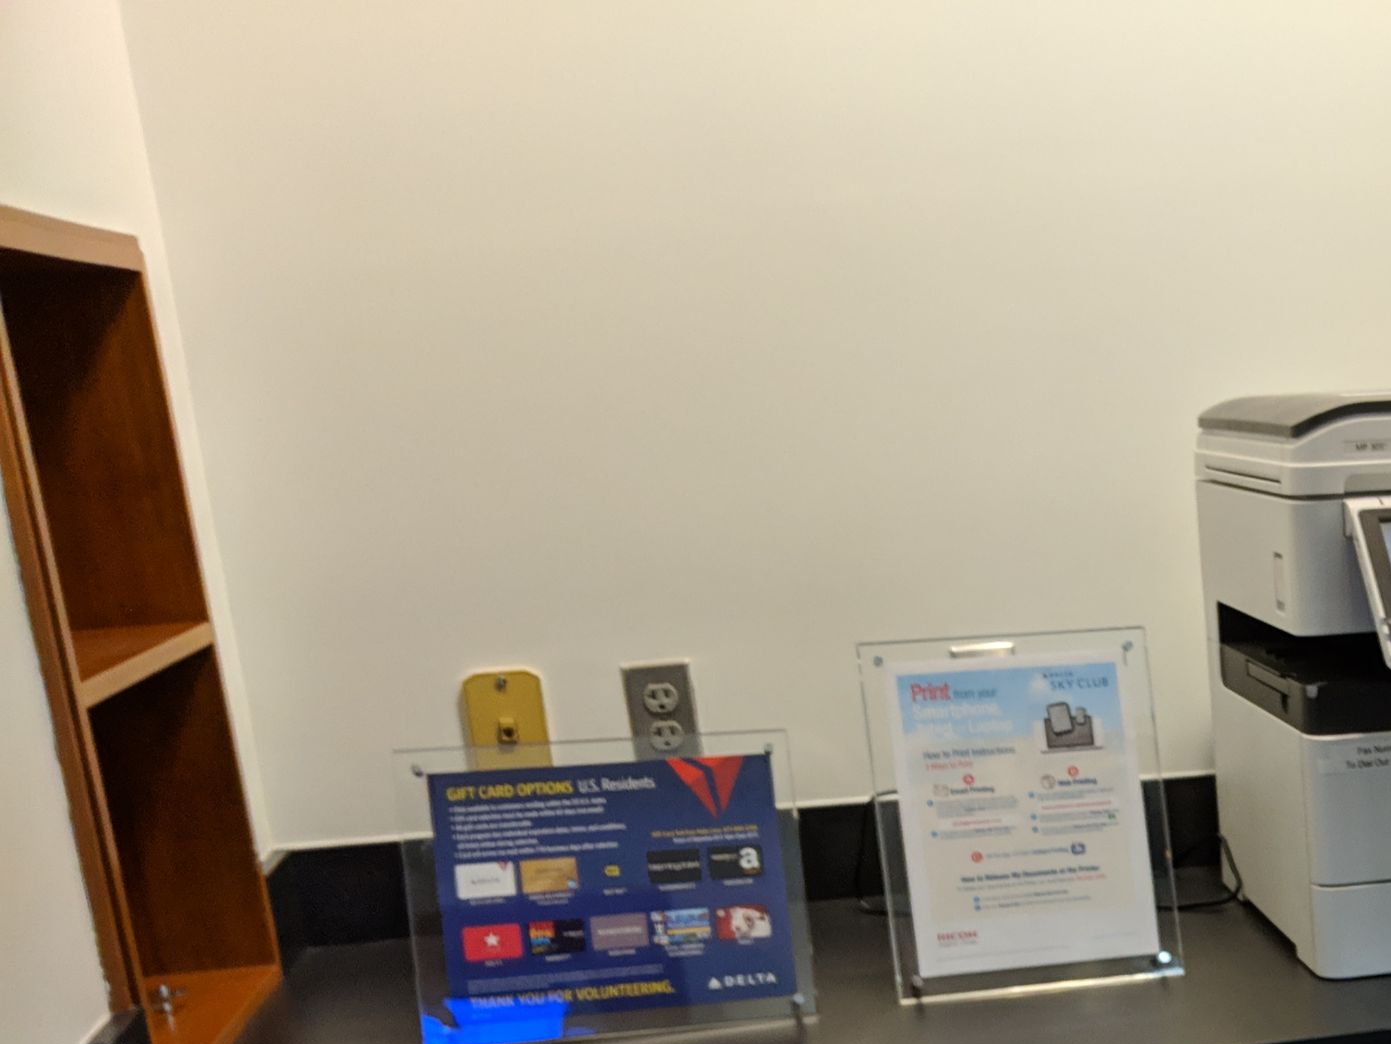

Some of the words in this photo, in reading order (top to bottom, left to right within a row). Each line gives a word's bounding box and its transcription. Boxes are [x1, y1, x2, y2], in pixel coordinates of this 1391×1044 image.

[910, 681, 951, 702] Print
[1076, 677, 1109, 689] CLUB
[446, 786, 475, 801] GIFT
[478, 783, 514, 799] CARD
[517, 781, 574, 796] OPTIONS
[601, 776, 656, 791] Residents
[724, 971, 777, 988] DELTA
[470, 994, 515, 1009] THANK
[517, 992, 542, 1007] YOU
[544, 990, 574, 1004] FOR
